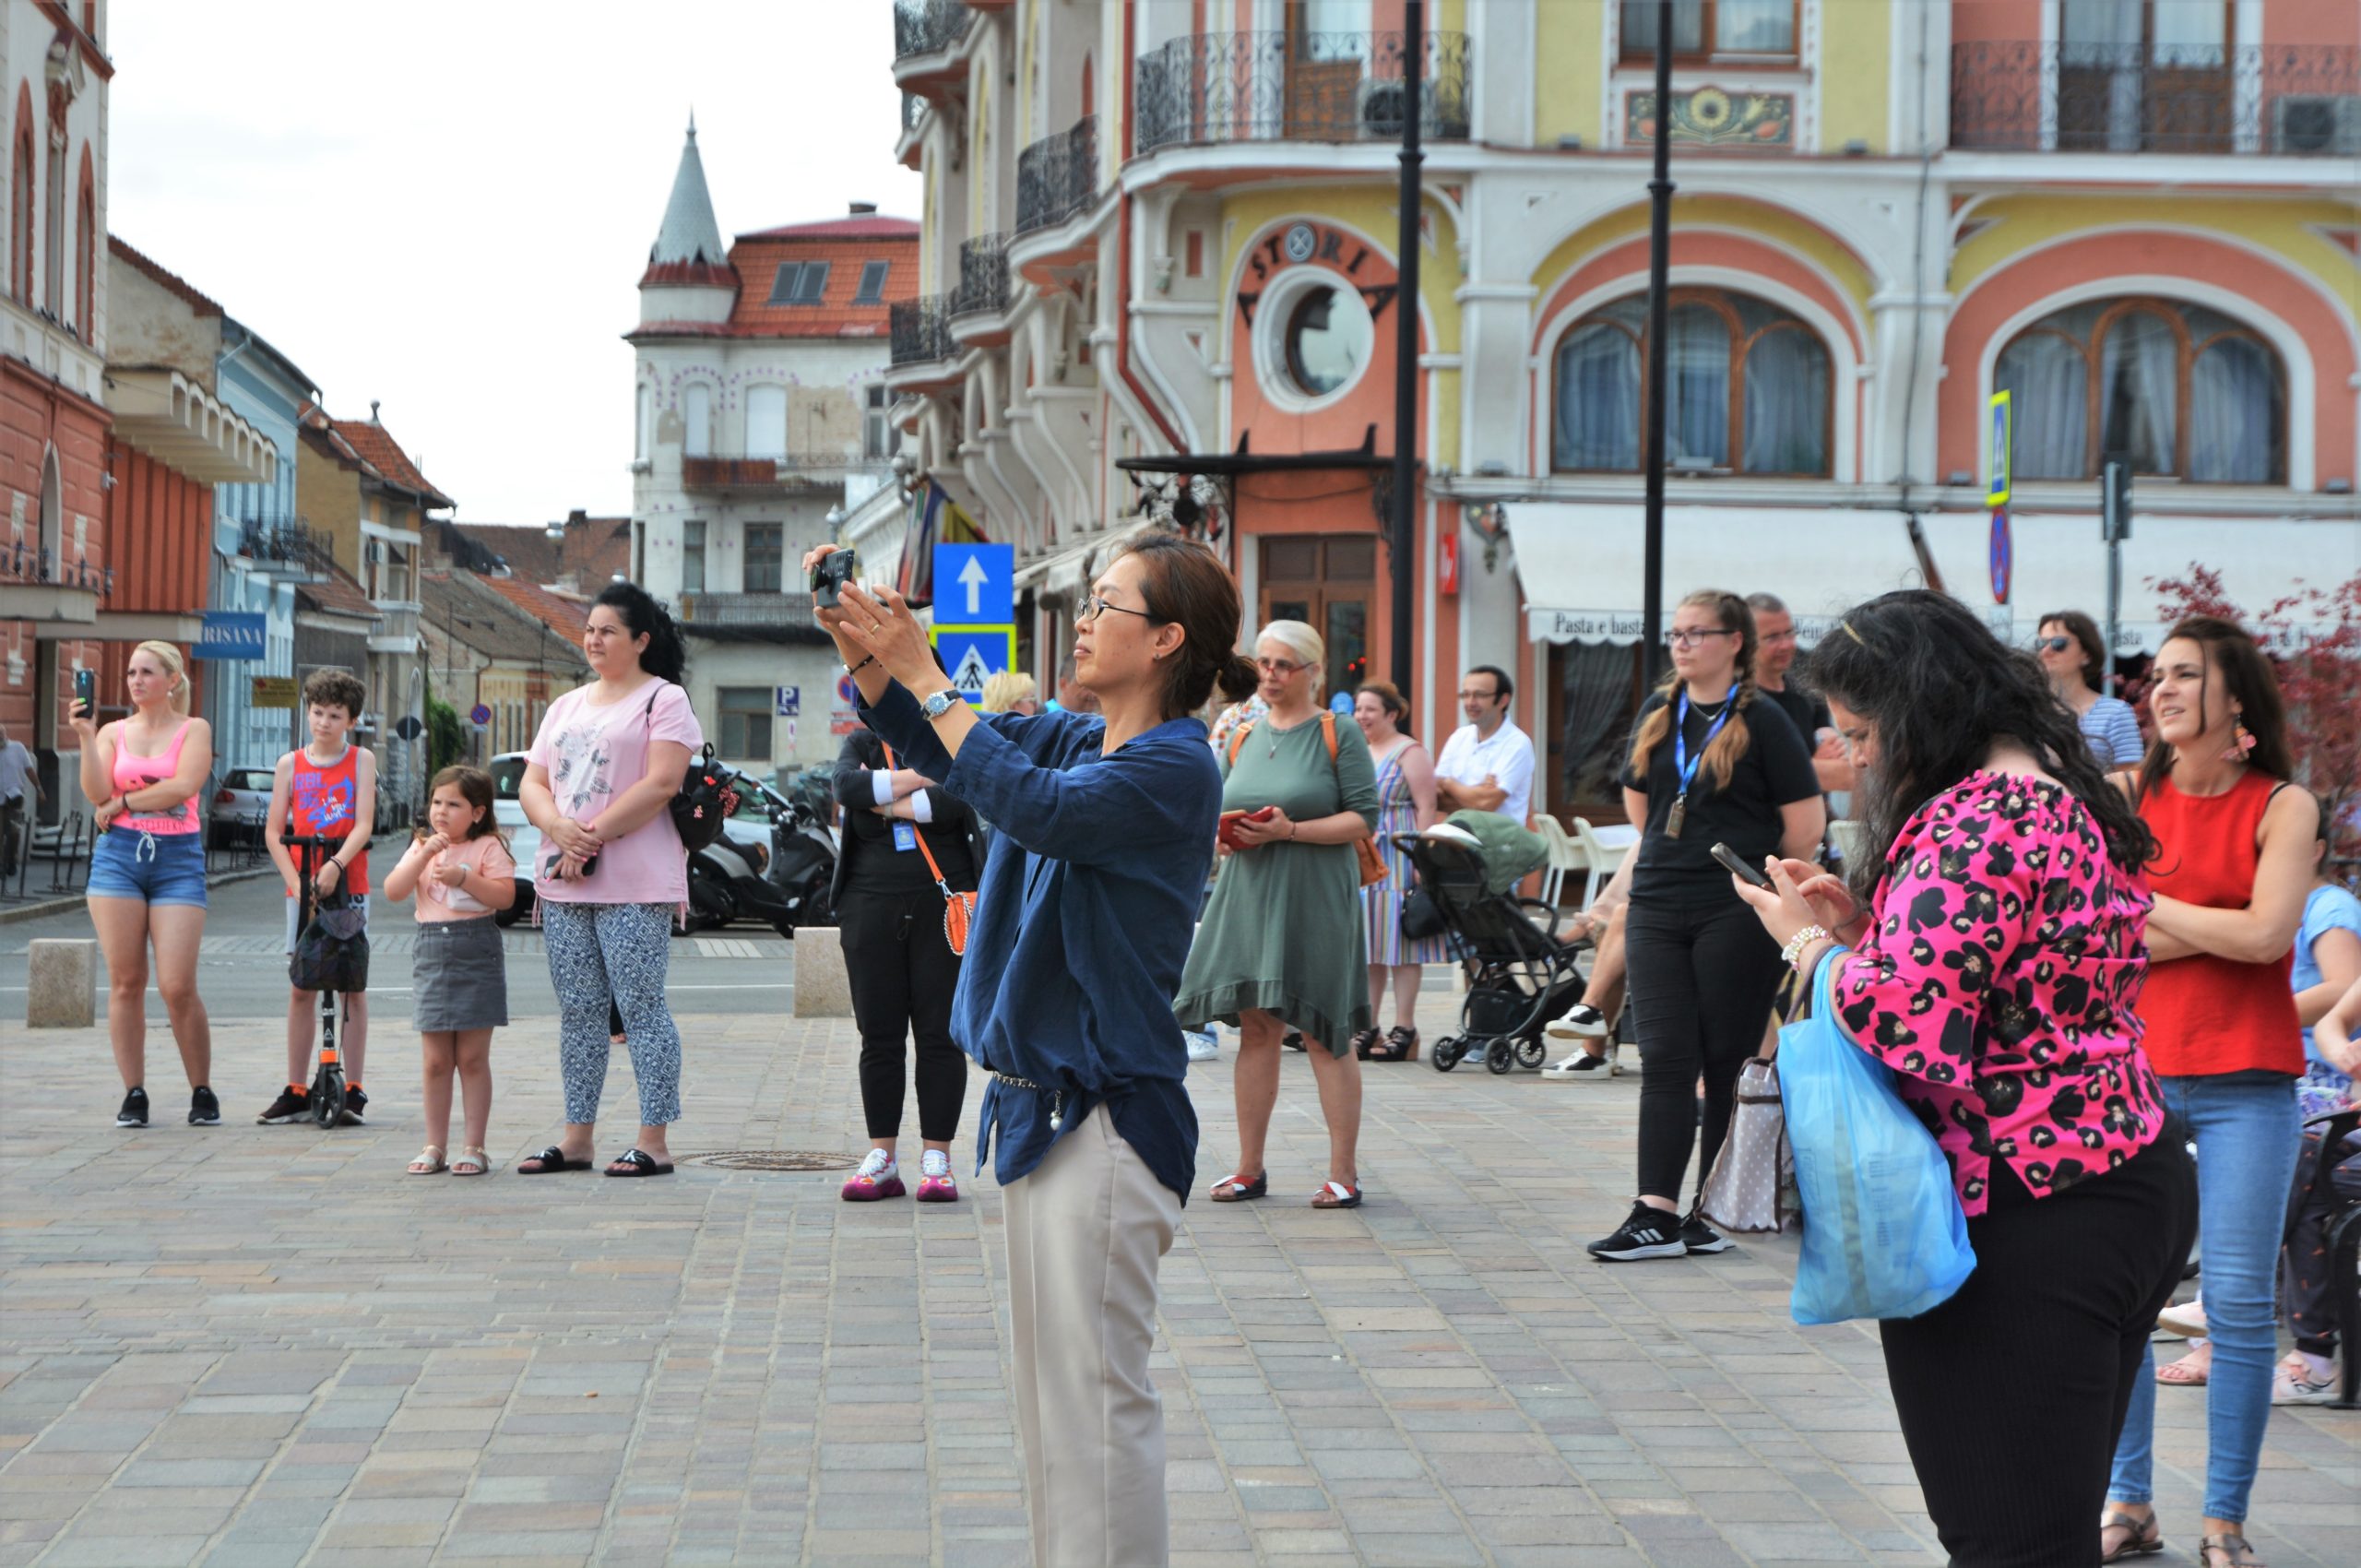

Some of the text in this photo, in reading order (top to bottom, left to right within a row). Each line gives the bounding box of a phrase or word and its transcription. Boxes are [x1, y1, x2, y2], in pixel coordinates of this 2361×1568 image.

[1555, 612, 1595, 634] Pasta
[1599, 619, 1608, 634] e
[202, 626, 263, 645] RISANA
[781, 688, 795, 706] P
